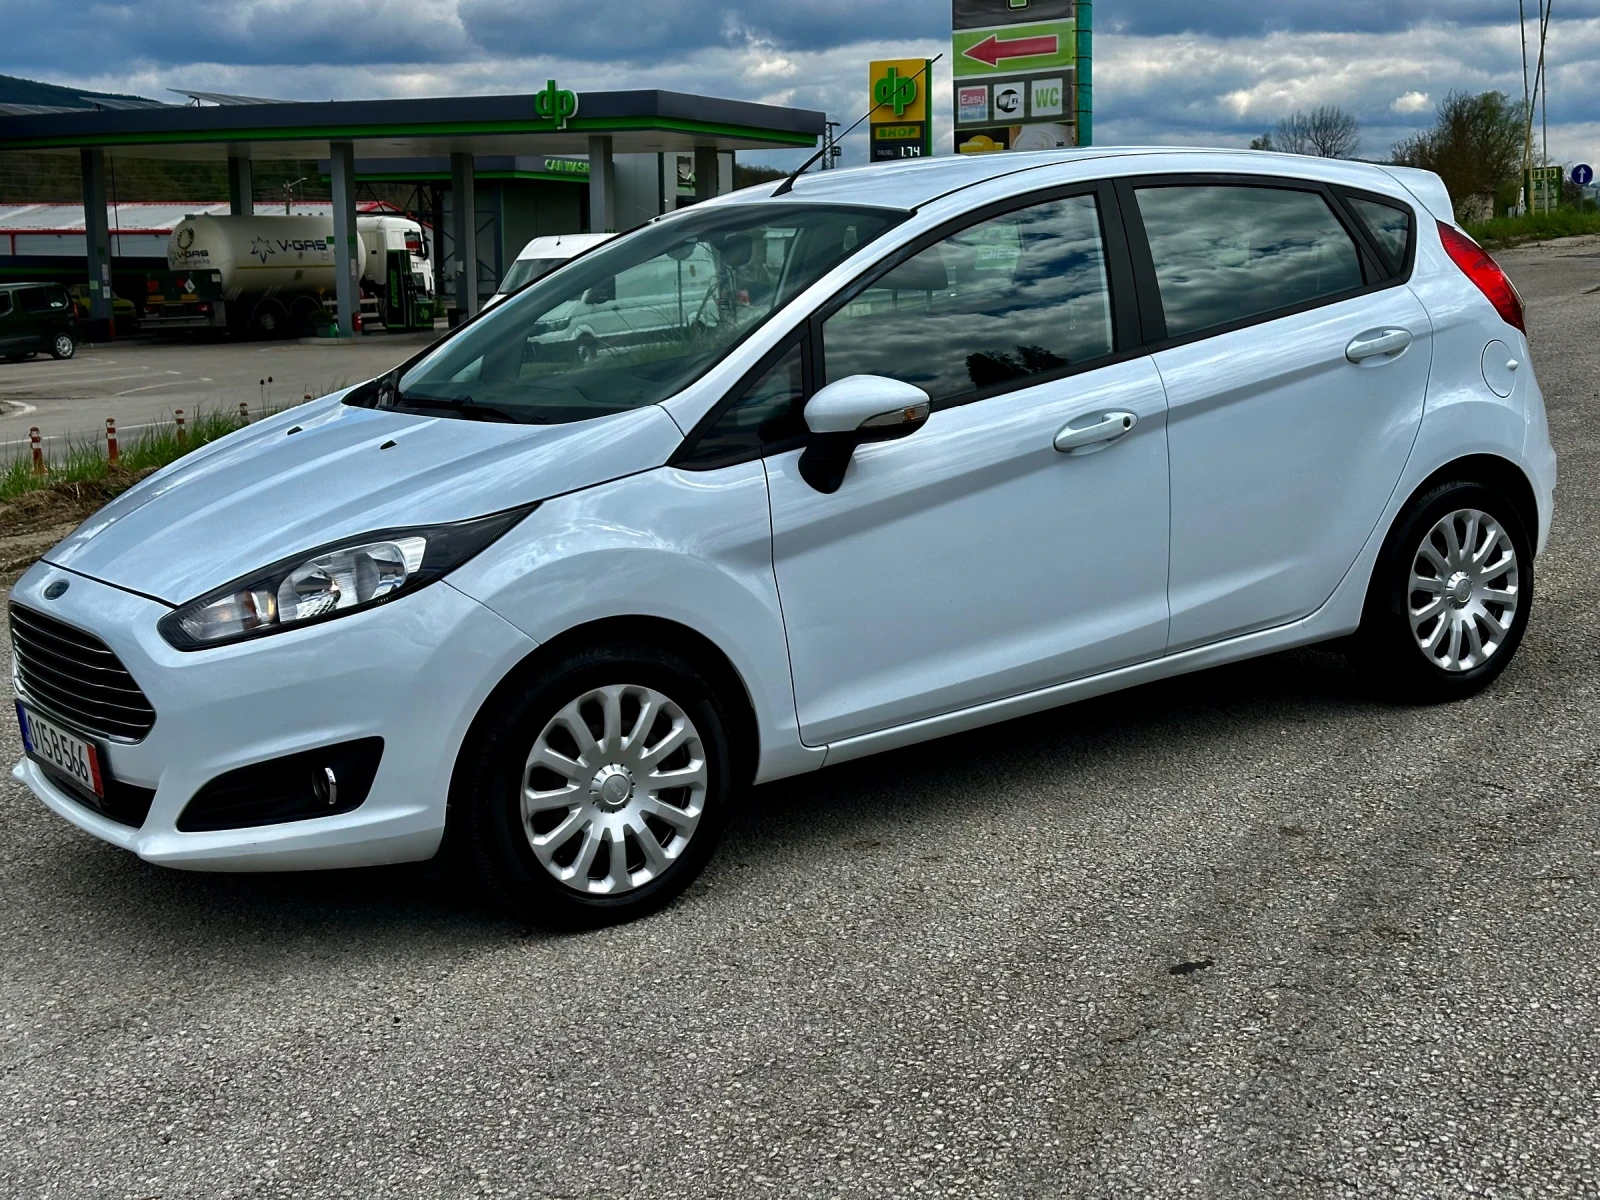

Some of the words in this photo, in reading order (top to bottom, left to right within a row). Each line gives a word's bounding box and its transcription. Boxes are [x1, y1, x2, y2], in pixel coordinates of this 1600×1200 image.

[535, 79, 579, 130] dp
[961, 95, 985, 107] Easy
[1036, 87, 1060, 109] WC
[879, 128, 916, 138] SHOP
[900, 146, 920, 157] 1.74
[544, 159, 563, 171] CAR
[565, 160, 590, 173] WASH
[28, 714, 88, 783] 015B566
